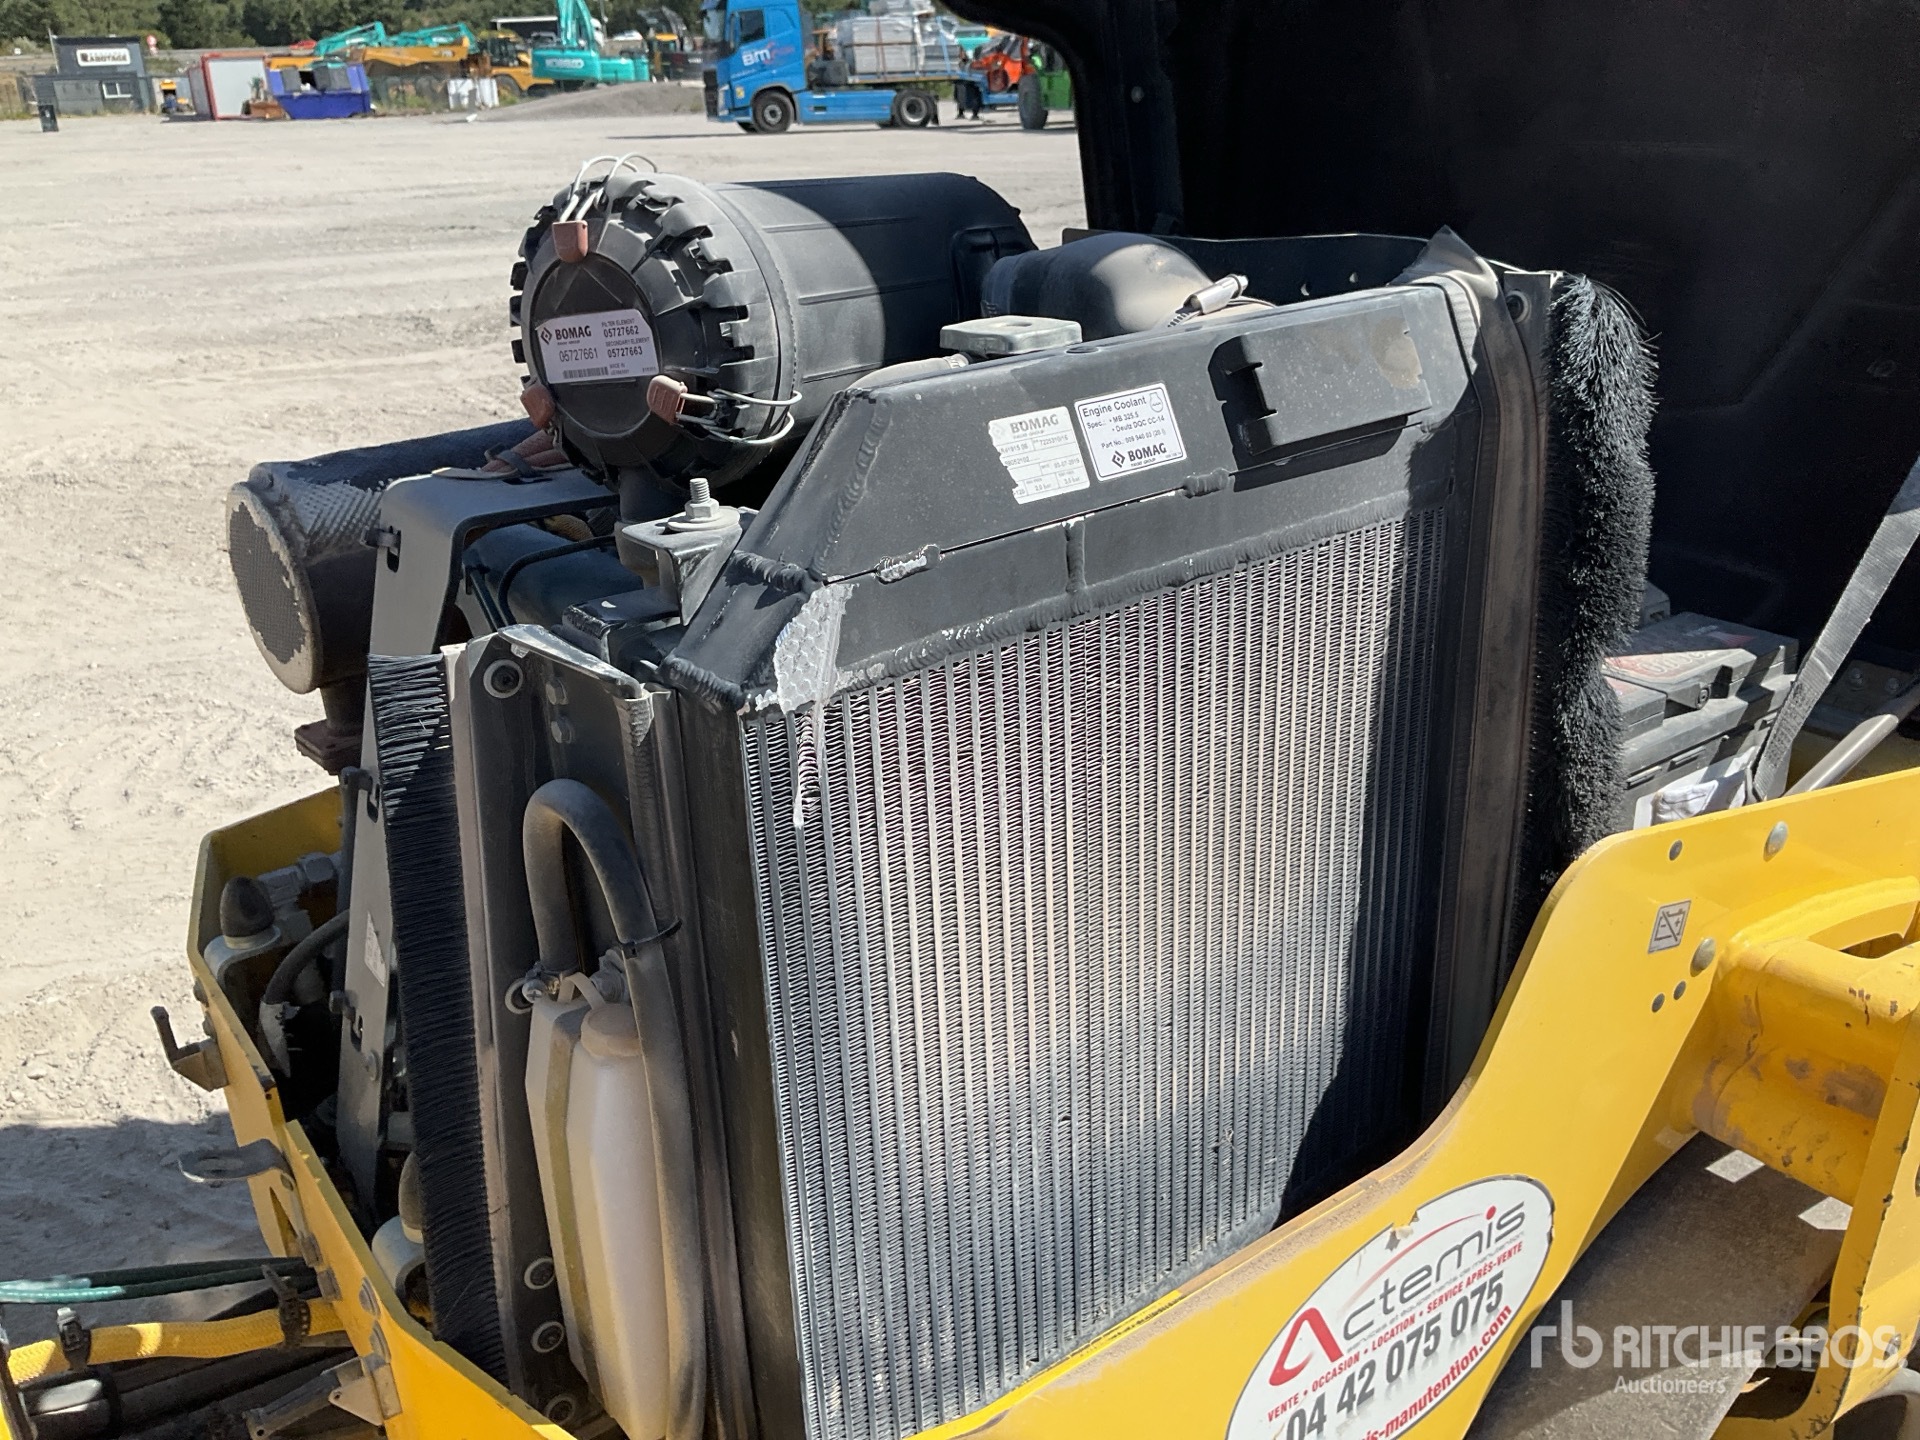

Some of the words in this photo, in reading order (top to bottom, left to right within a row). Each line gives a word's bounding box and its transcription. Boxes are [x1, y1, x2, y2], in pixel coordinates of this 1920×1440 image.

[555, 326, 592, 341] BOMAG
[604, 325, 639, 338] 05727662
[559, 347, 598, 362] 05727661
[608, 346, 643, 358] 05727663
[1082, 404, 1113, 418] Engine
[1113, 396, 1147, 411] Coolant
[1009, 413, 1059, 434] BOMAG
[1112, 415, 1123, 423] MB
[1124, 411, 1139, 421] 325.5
[1116, 423, 1132, 432] Deutz
[1133, 419, 1147, 428] DQC
[1148, 414, 1165, 425] CC-14
[1101, 441, 1113, 449] Part
[1127, 442, 1167, 462] BOMAG
[1269, 1201, 1525, 1387] Actemis
[1267, 1392, 1299, 1422] VENTE
[1311, 1351, 1361, 1393] OCCASION
[1372, 1313, 1416, 1353] LOCATION
[1427, 1281, 1464, 1314] SERVICE
[1465, 1240, 1523, 1288] APRÈS-VENTE
[1286, 1392, 1328, 1440] 04
[1337, 1359, 1377, 1415] 42
[1386, 1311, 1442, 1384] 075
[1450, 1269, 1504, 1338] 075
